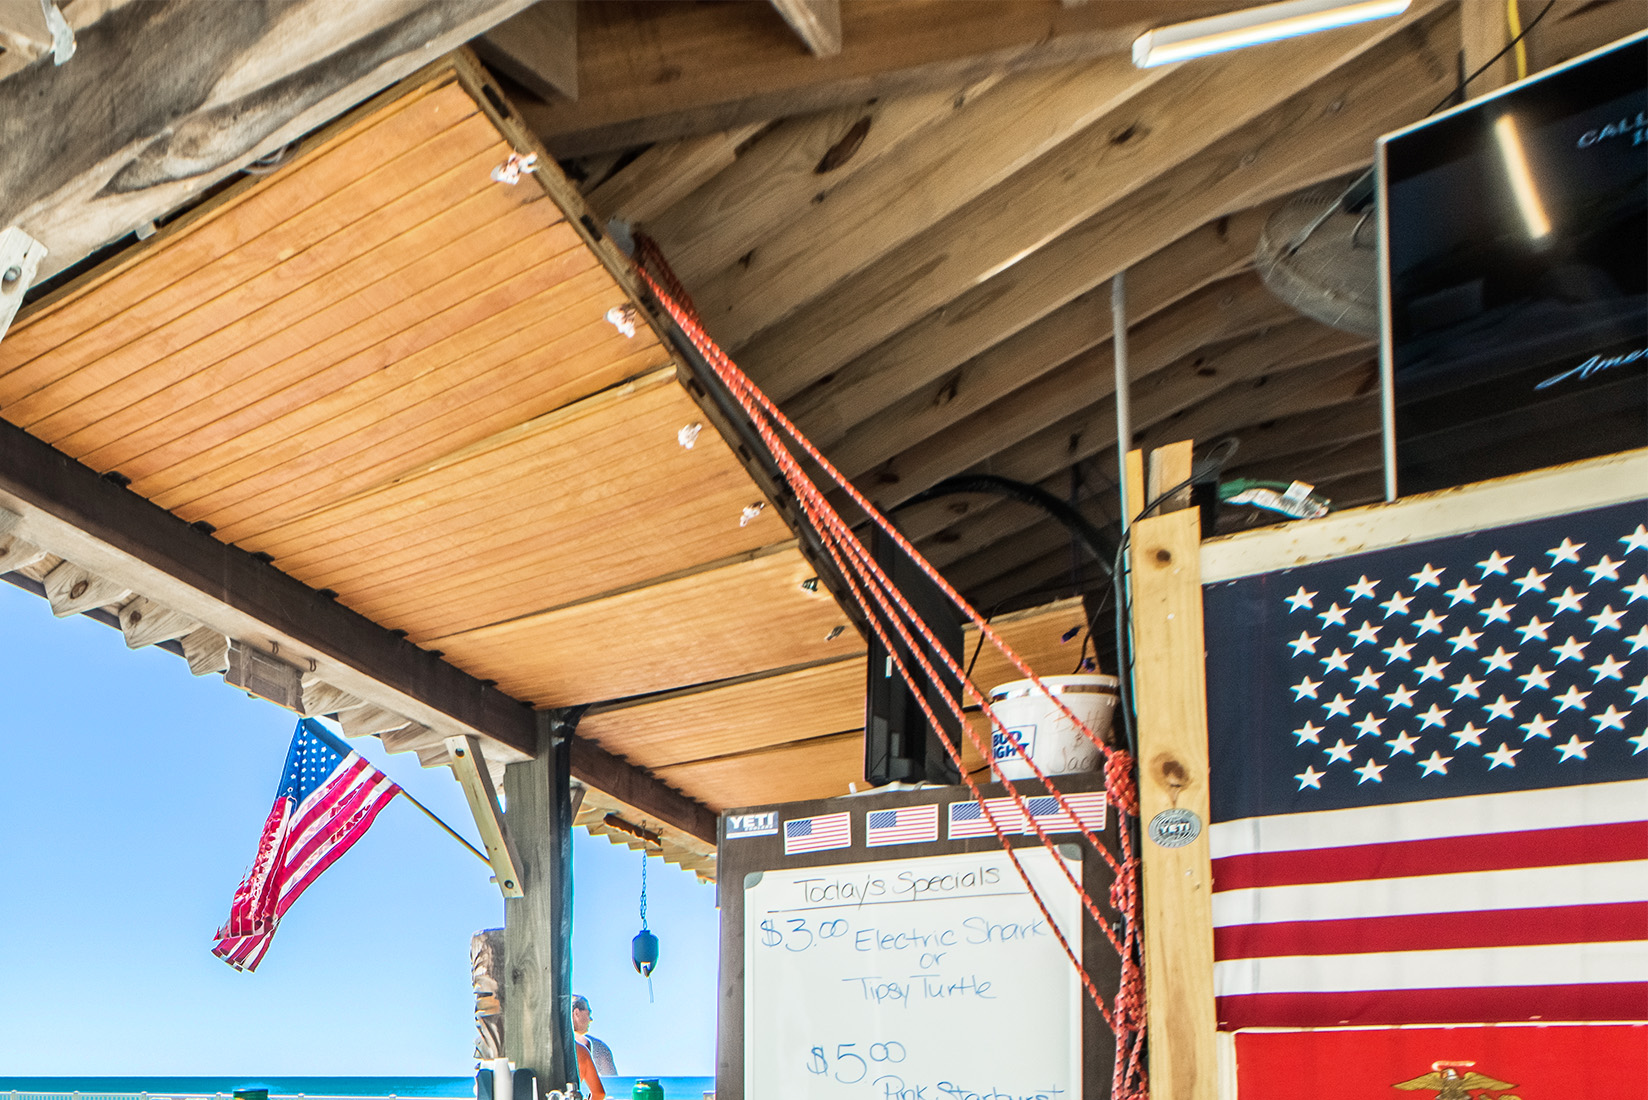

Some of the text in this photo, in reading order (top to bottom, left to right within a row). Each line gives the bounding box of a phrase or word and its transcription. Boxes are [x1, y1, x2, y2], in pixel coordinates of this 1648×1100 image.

[993, 743, 1030, 759] IGHT
[730, 811, 776, 830] YETI
[1160, 821, 1191, 835] YETI
[793, 866, 1001, 910] Today's Specials
[760, 916, 1049, 952] $3.00 Electric Shark
[919, 952, 947, 970] or
[841, 974, 997, 1009] Tipsy Turtle
